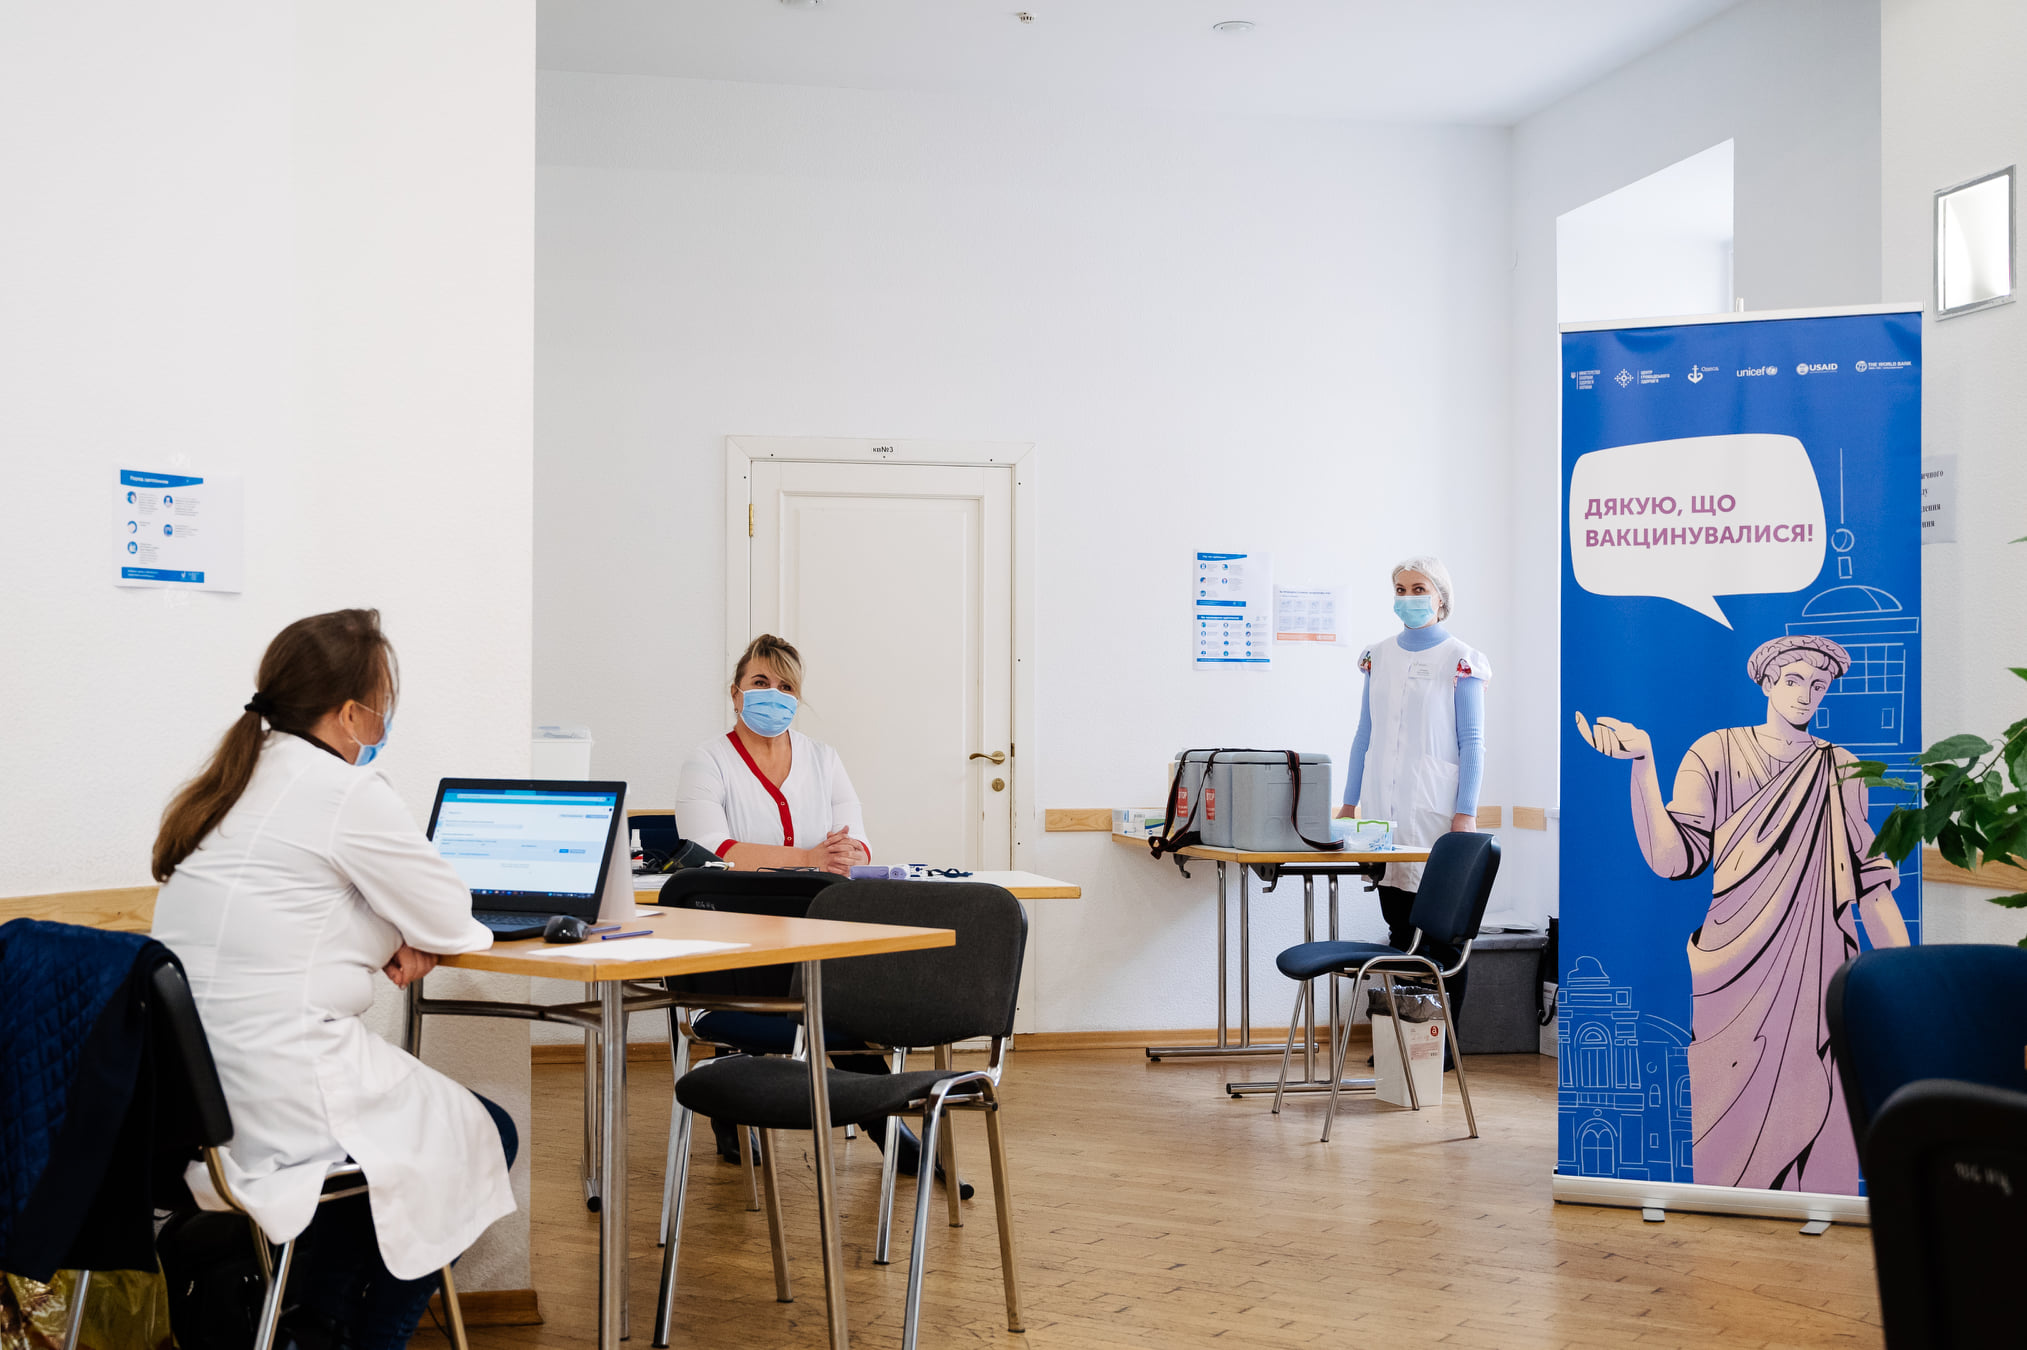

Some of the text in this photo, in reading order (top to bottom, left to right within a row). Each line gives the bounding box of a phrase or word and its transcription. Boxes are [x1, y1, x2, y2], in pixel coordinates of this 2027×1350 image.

[1736, 366, 1765, 377] unicef
[1809, 363, 1838, 371] USAID
[1584, 494, 1736, 520] ДЯКУЮ, ЩО
[1585, 523, 1814, 549] ВАКЦИНУВАЛИСЯ!
